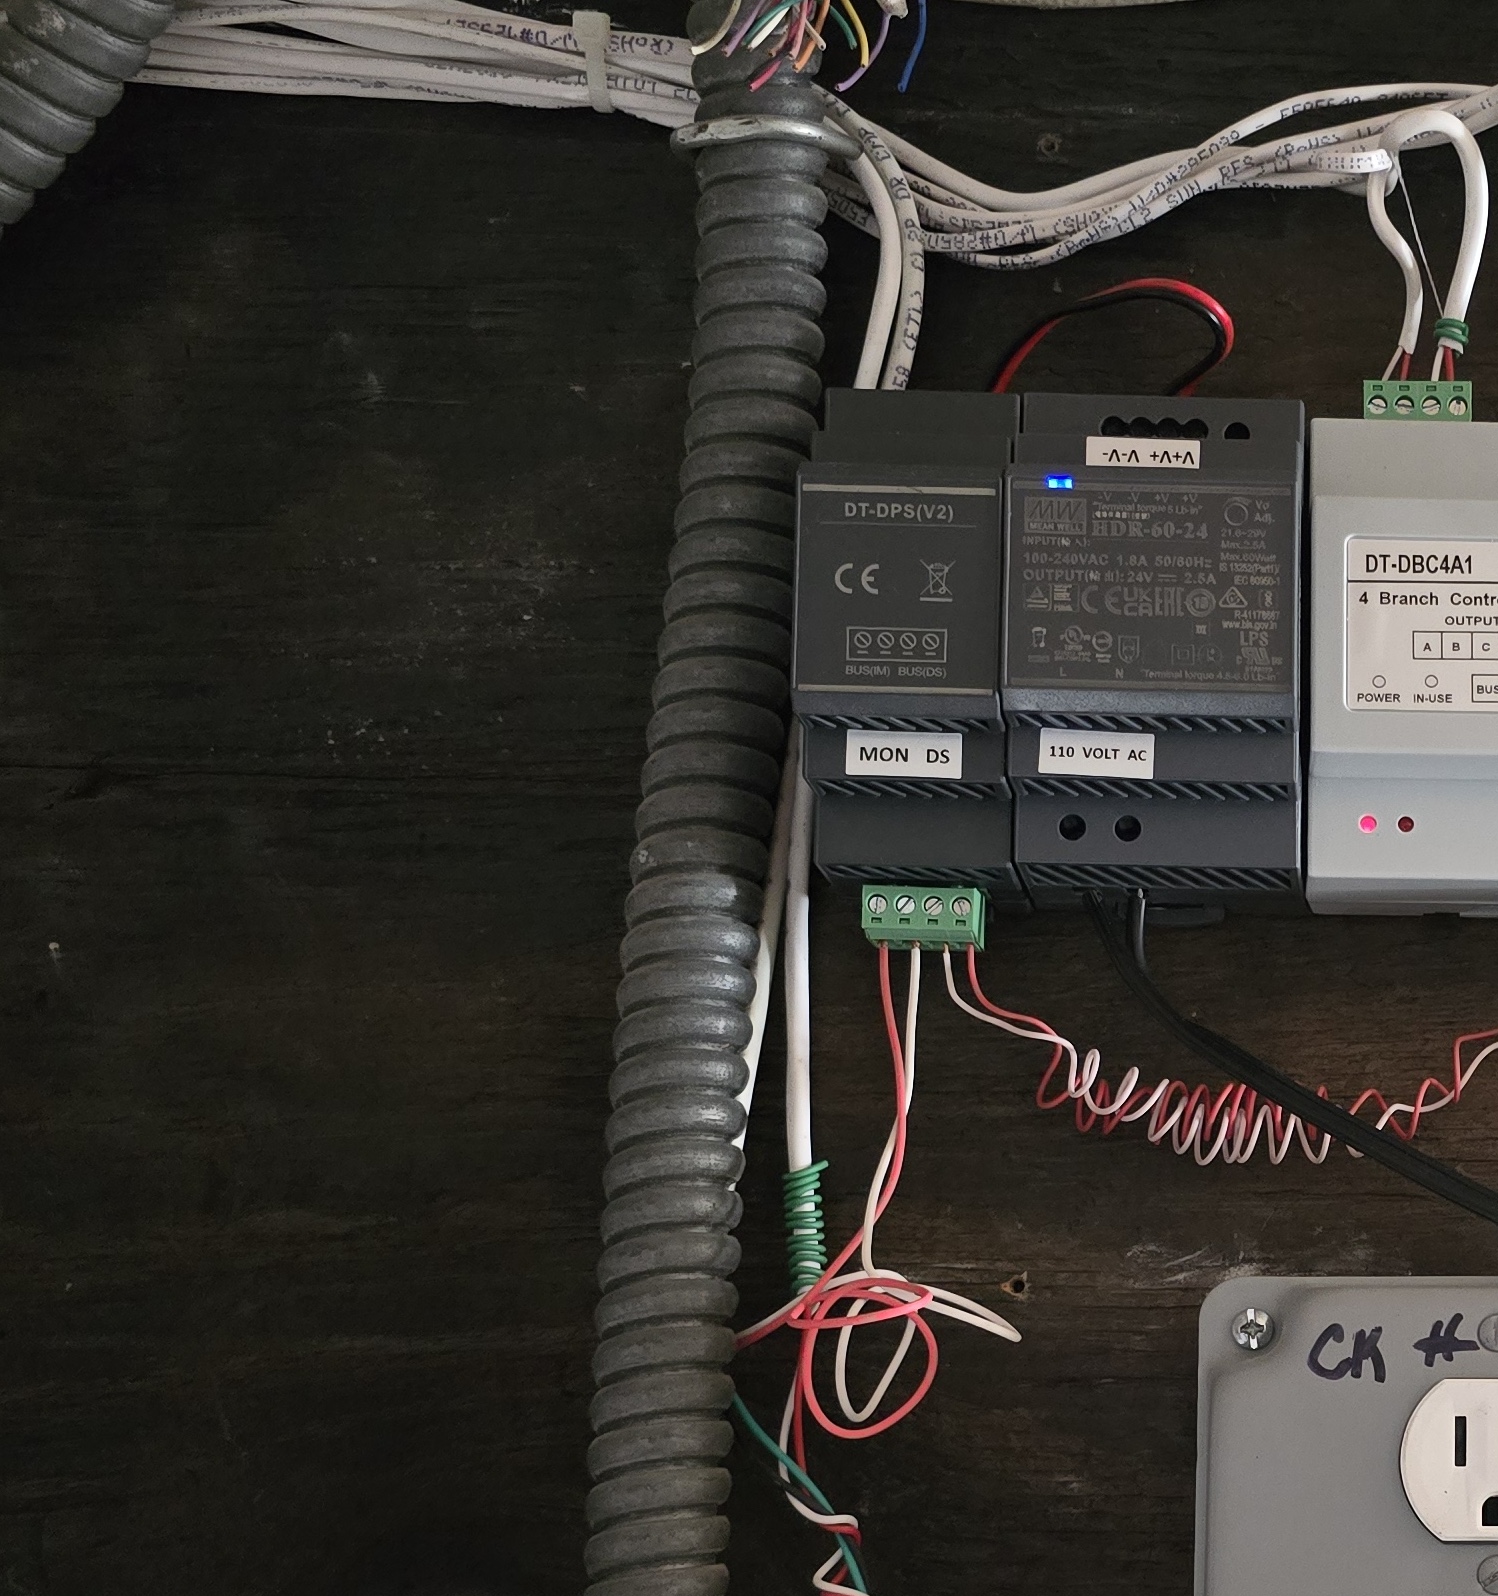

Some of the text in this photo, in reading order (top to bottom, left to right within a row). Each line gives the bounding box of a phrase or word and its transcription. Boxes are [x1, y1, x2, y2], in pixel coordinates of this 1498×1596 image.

[844, 502, 954, 523] DT-DPS(V2)
[1029, 522, 1081, 532] MEAN WELL
[1092, 520, 1208, 539] HDR-60-24
[1023, 552, 1212, 568] 100-240VAC 1.8A 50/60Hz
[1366, 554, 1472, 574] DT-DBC4A1
[1184, 572, 1216, 585] 2.5A
[1359, 592, 1368, 605] 4
[1380, 592, 1439, 606] Branch
[1239, 631, 1269, 647] LPS
[1423, 642, 1432, 652] A
[1452, 642, 1460, 652] B
[1482, 642, 1491, 652] C
[845, 664, 947, 679] BUS(IM) BUS(DS)
[1357, 693, 1452, 704] POWER IN-USE
[859, 746, 950, 764] MON DS
[1049, 745, 1148, 763] 110 VOLT AC
[1413, 1312, 1480, 1368] #
